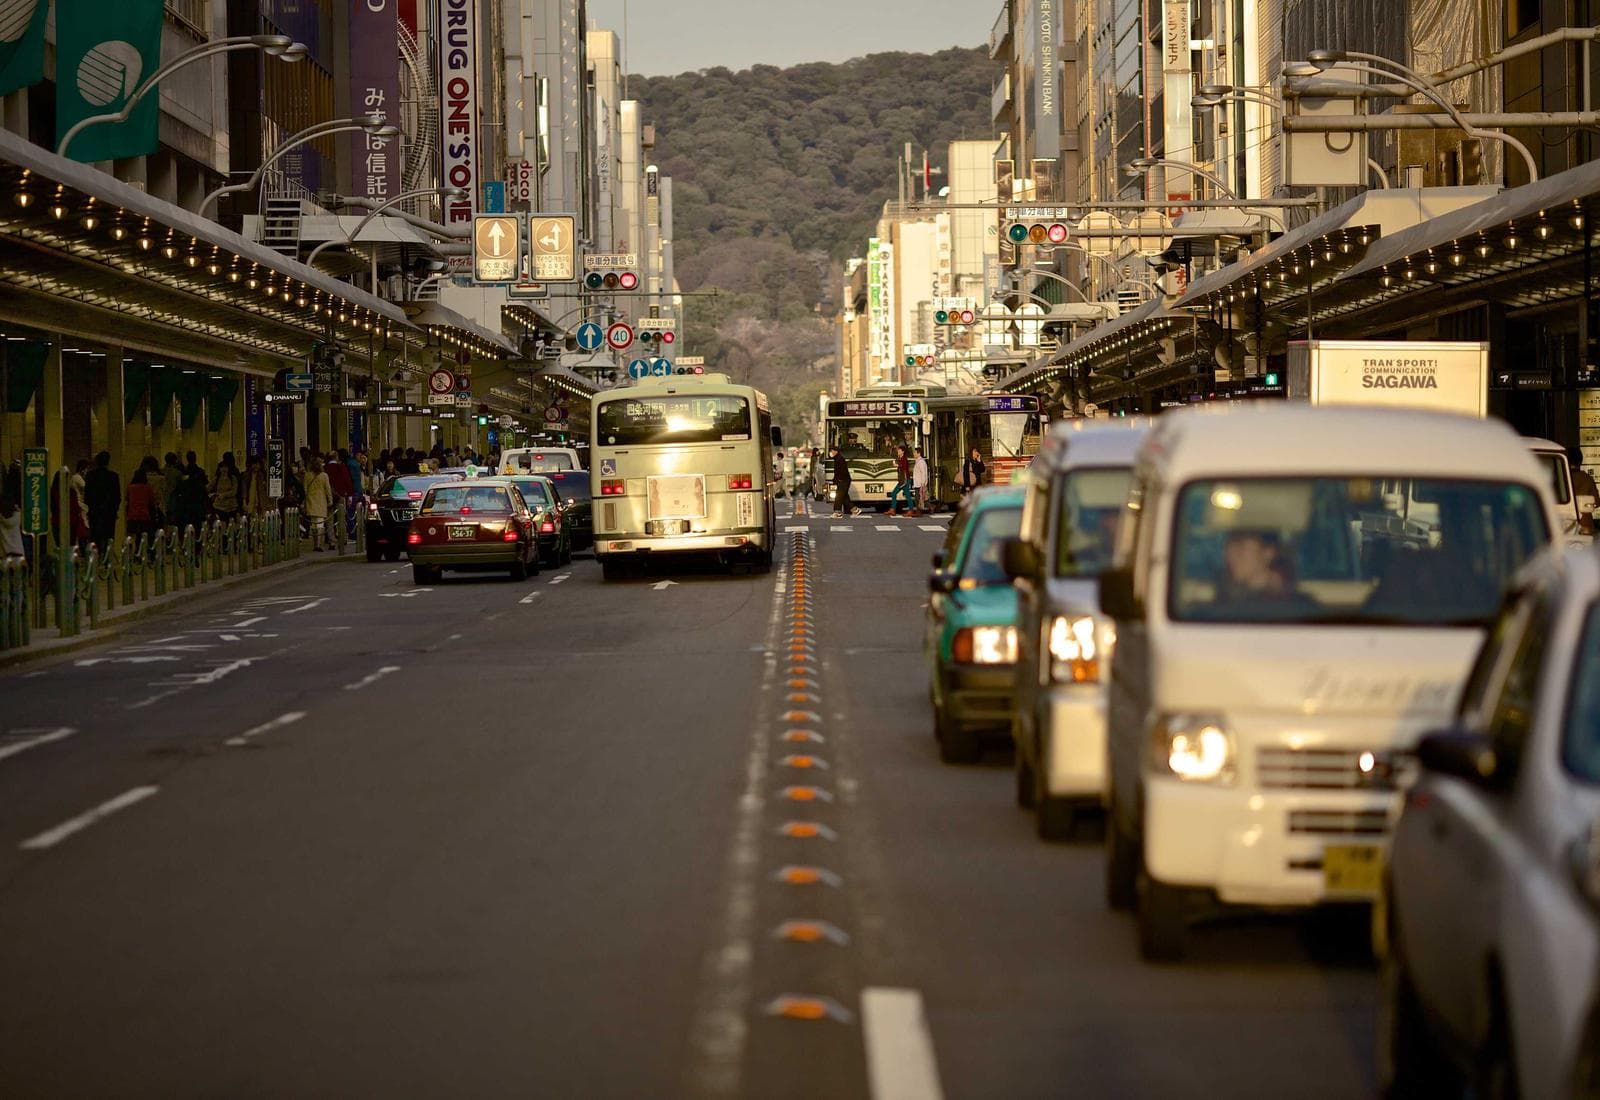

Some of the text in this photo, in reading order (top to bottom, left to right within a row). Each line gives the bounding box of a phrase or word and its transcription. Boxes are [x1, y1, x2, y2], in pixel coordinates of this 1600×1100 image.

[1041, 11, 1051, 43] KYOTO
[1168, 10, 1178, 64] ランモア
[1042, 46, 1052, 86] SHINKIN
[1042, 88, 1053, 115] BANK
[520, 160, 533, 203] doco
[586, 255, 634, 266] 歩車分離信号
[882, 263, 890, 360] TAKASHIMAYA
[613, 329, 628, 342] 40
[1362, 375, 1438, 388] SAGAWA
[889, 403, 900, 413] 5
[26, 453, 45, 461] TAXI
